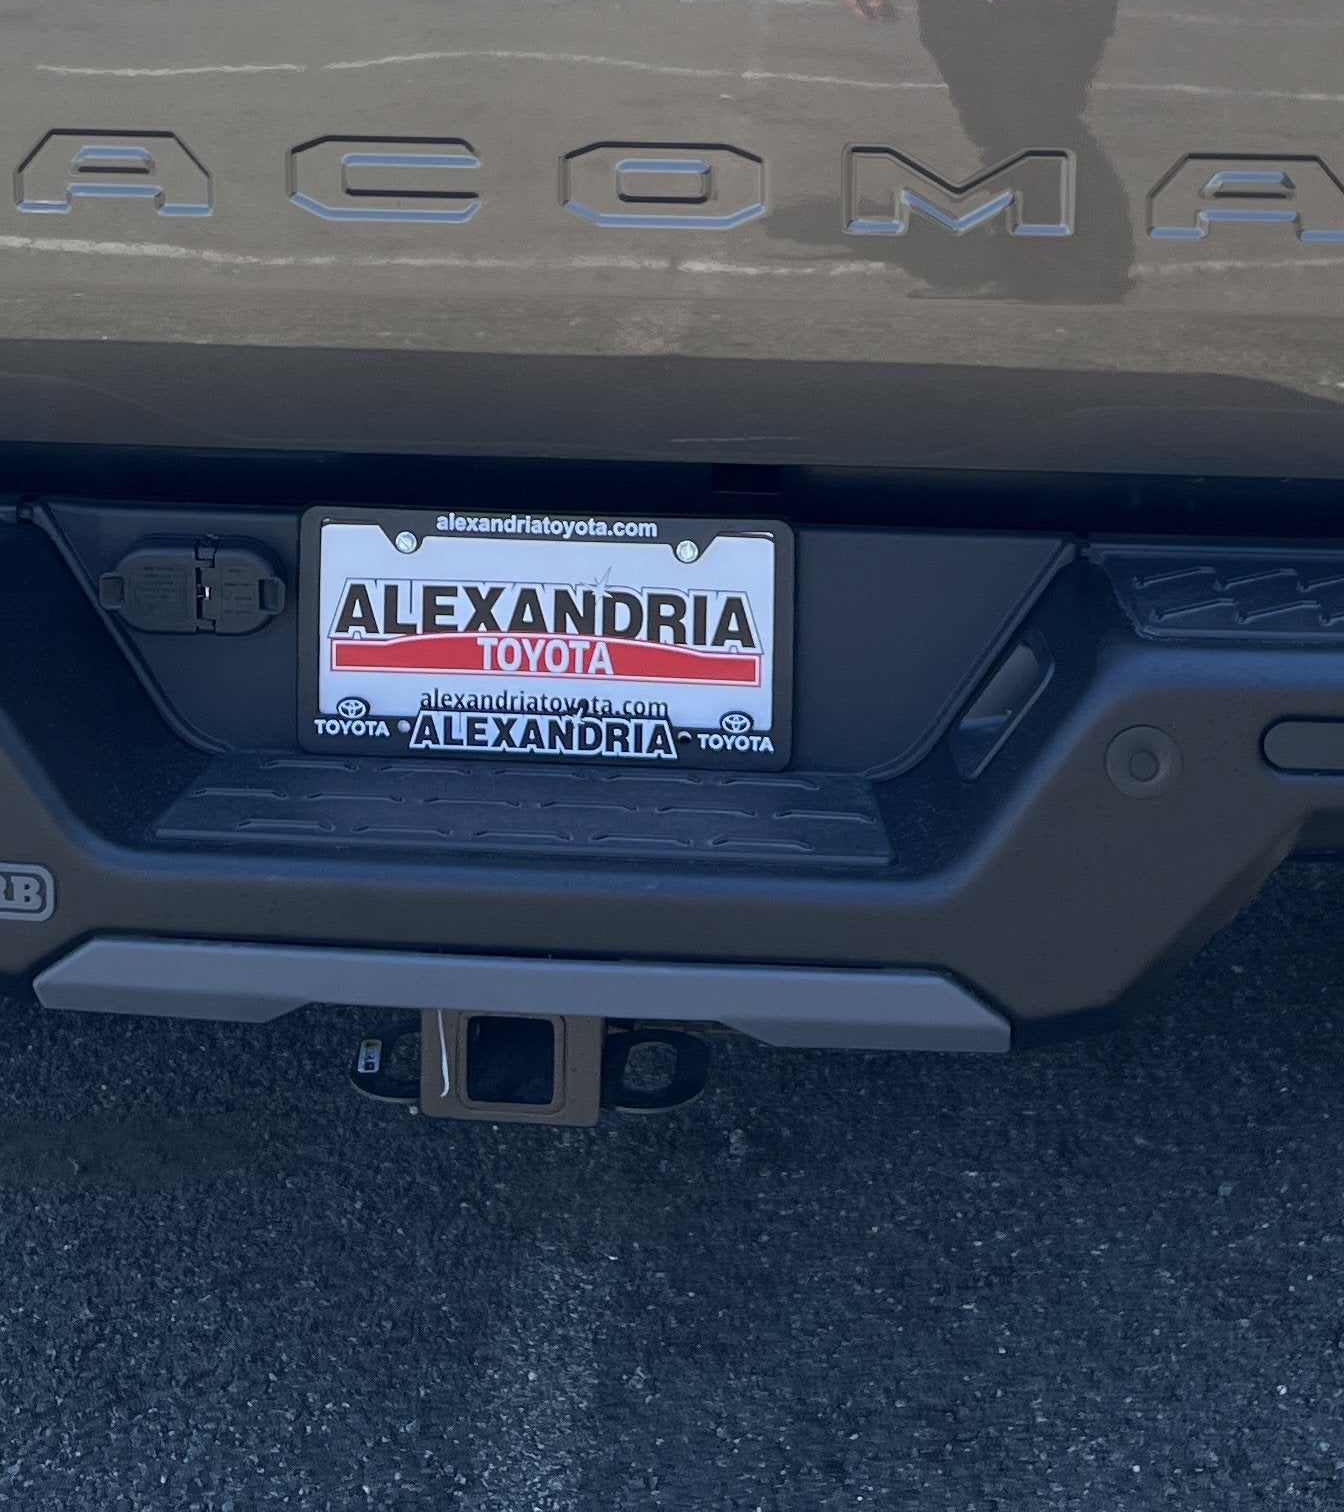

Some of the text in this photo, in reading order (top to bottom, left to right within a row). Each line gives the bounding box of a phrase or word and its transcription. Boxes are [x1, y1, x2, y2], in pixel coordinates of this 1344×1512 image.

[436, 513, 659, 538] alexandriatoyota.com
[334, 581, 757, 650] ALEXANDRIA
[476, 636, 615, 675] TOYOTA
[315, 719, 390, 738] TOYOTA
[413, 715, 674, 756] ALEXANDRIA
[697, 733, 774, 753] TOYOTA
